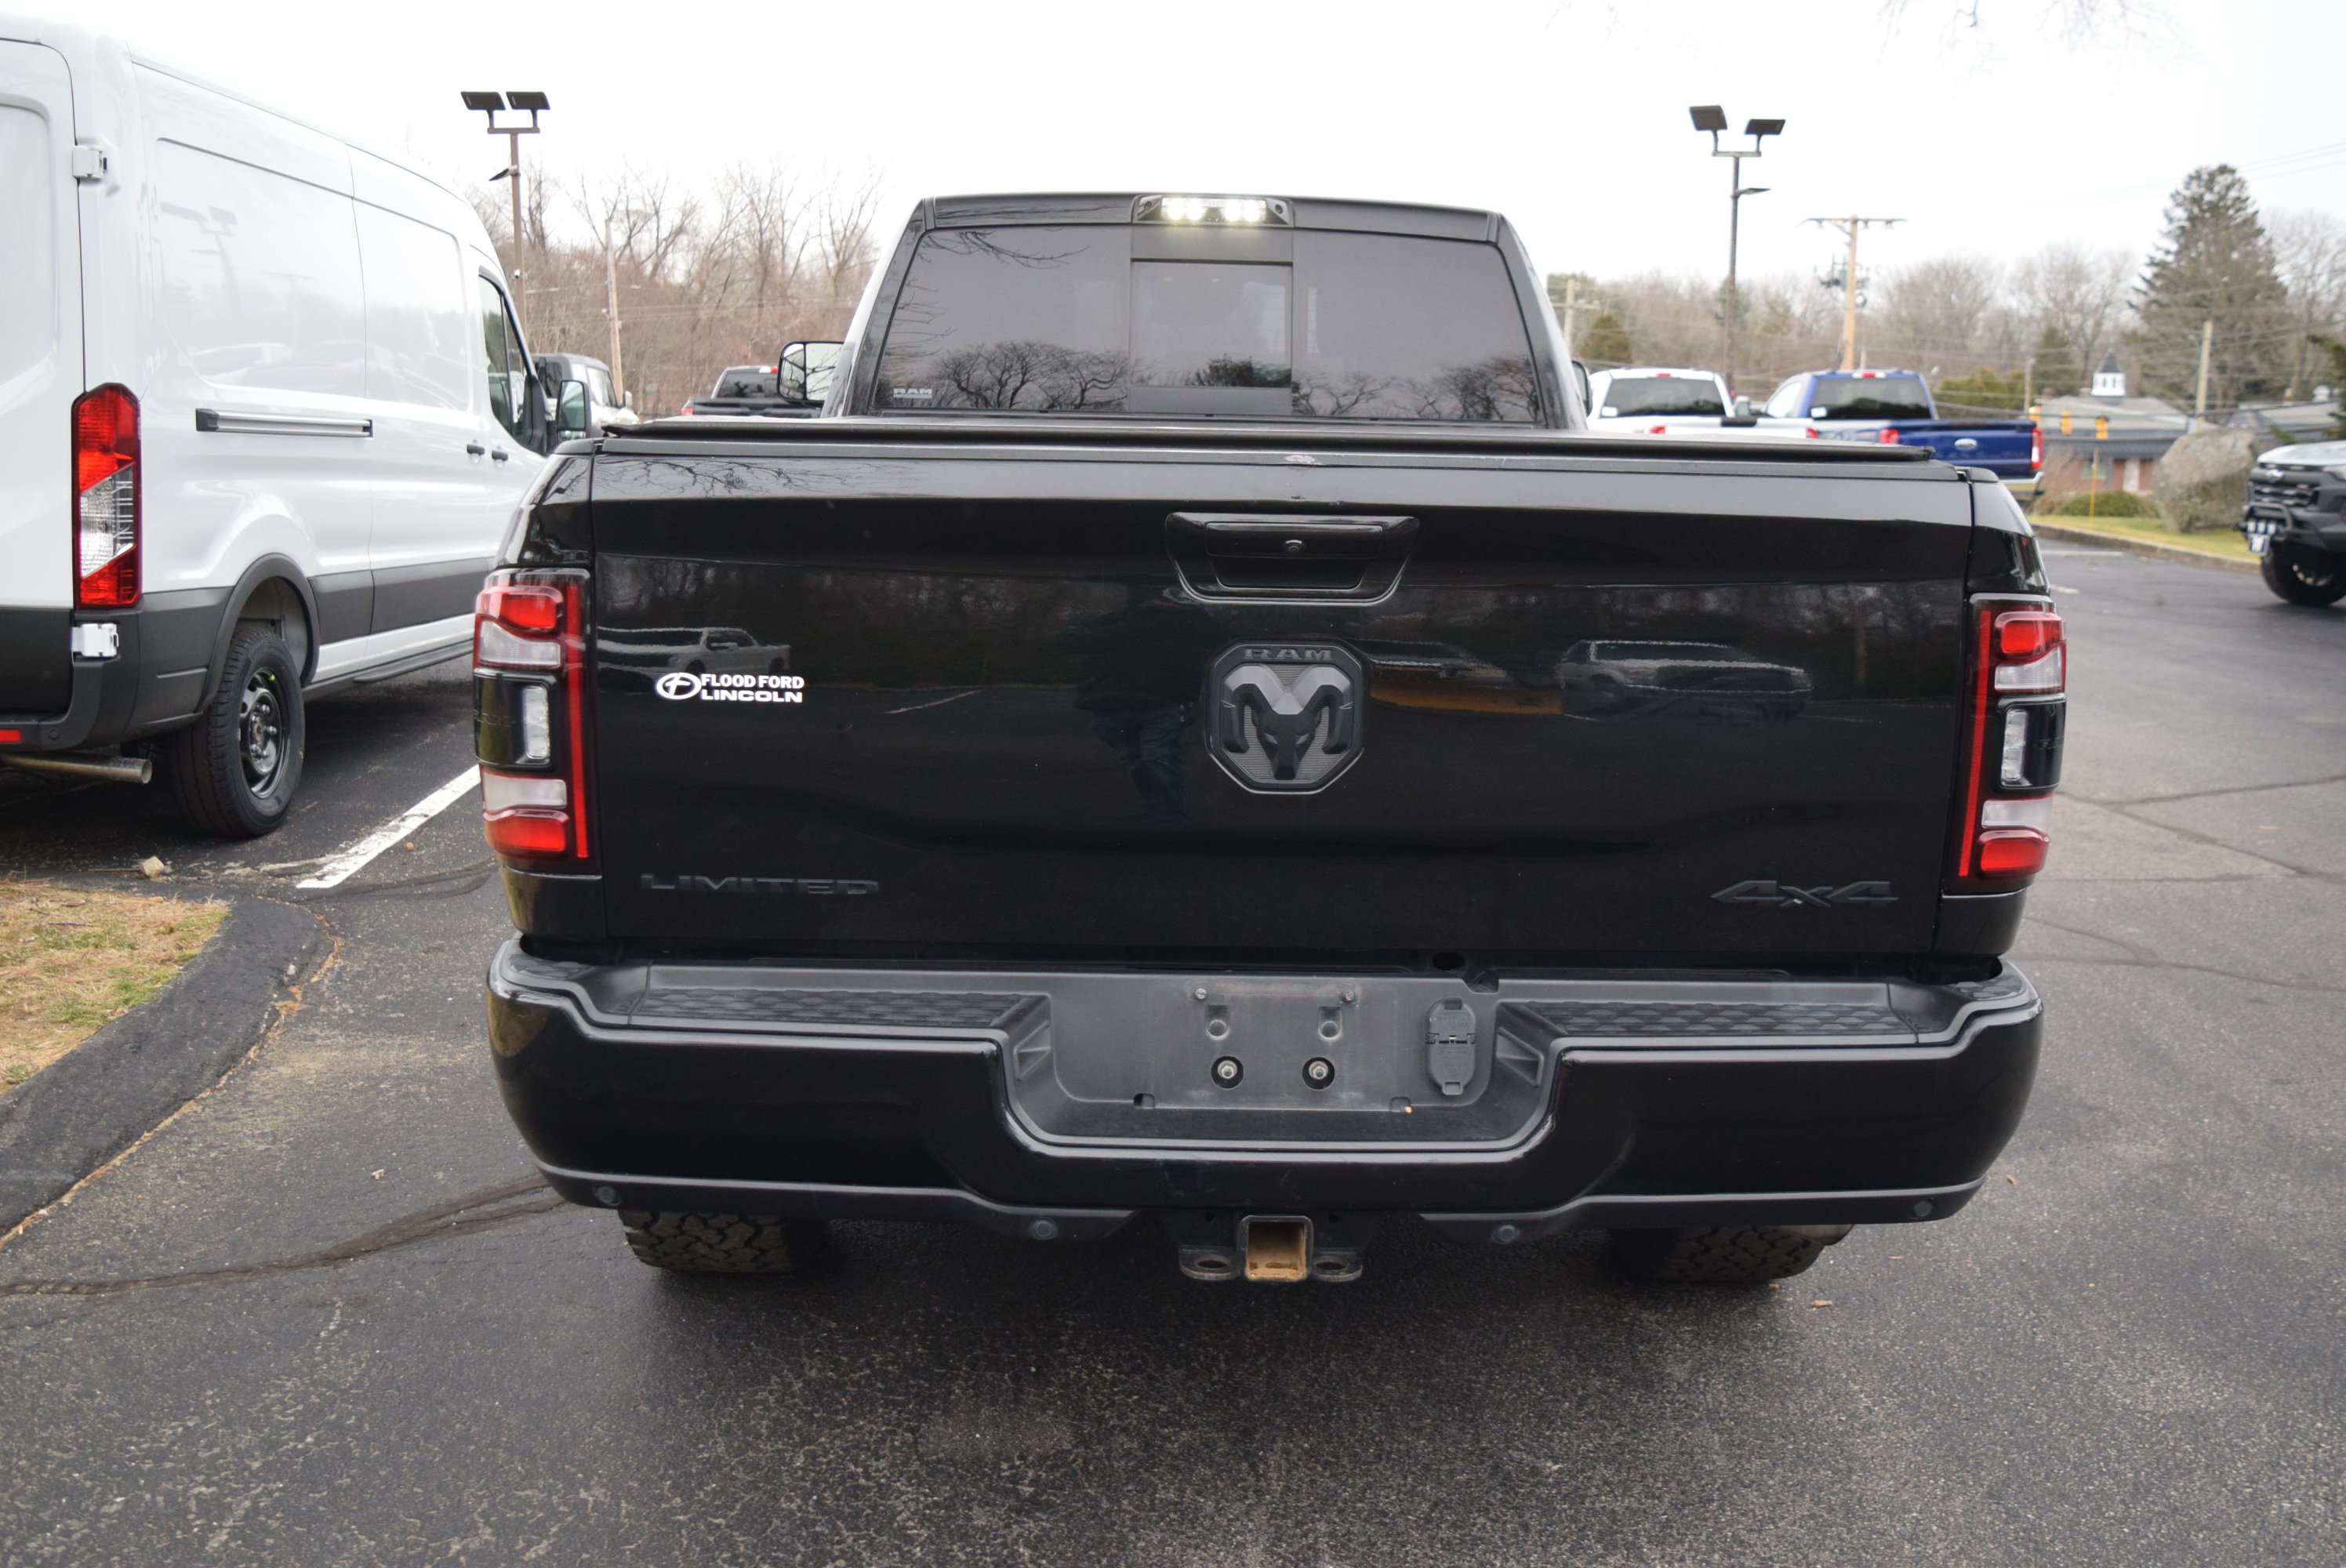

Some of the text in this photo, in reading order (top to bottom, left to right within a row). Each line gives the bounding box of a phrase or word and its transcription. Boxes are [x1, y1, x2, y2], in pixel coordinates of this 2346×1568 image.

[1244, 648, 1332, 660] RAM
[701, 673, 804, 689] FLOOD FORD
[701, 689, 803, 702] LINCOLN
[641, 873, 879, 895] LIMITED
